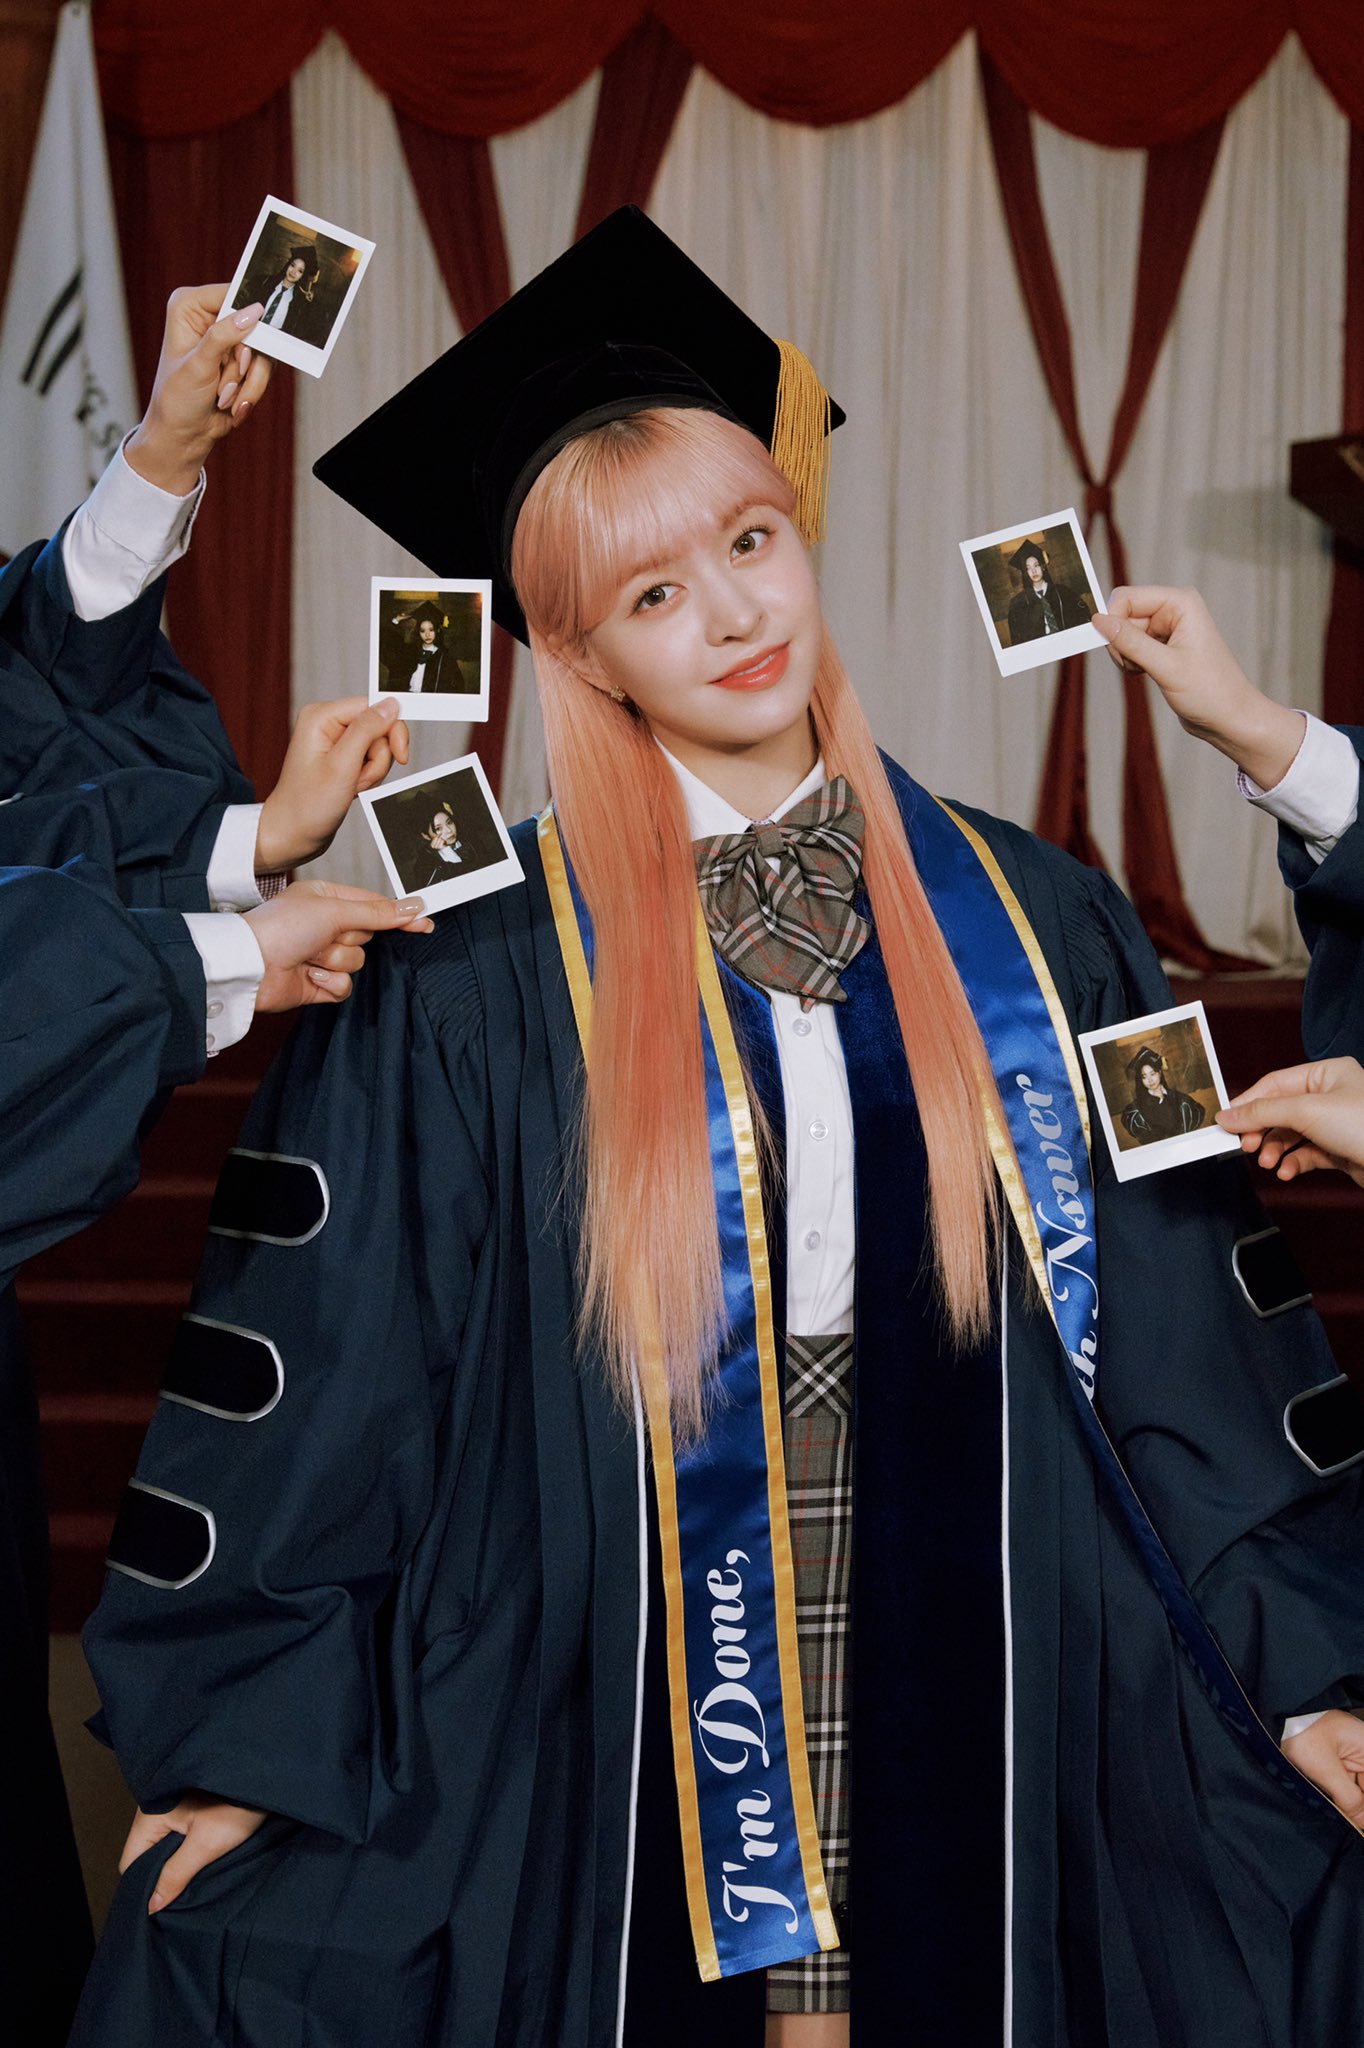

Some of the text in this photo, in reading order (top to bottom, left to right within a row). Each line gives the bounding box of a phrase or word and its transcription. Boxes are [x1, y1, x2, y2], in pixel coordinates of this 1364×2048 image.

[1015, 1073, 1099, 1321] Nswer
[693, 1548, 799, 1935] I'm Done,
